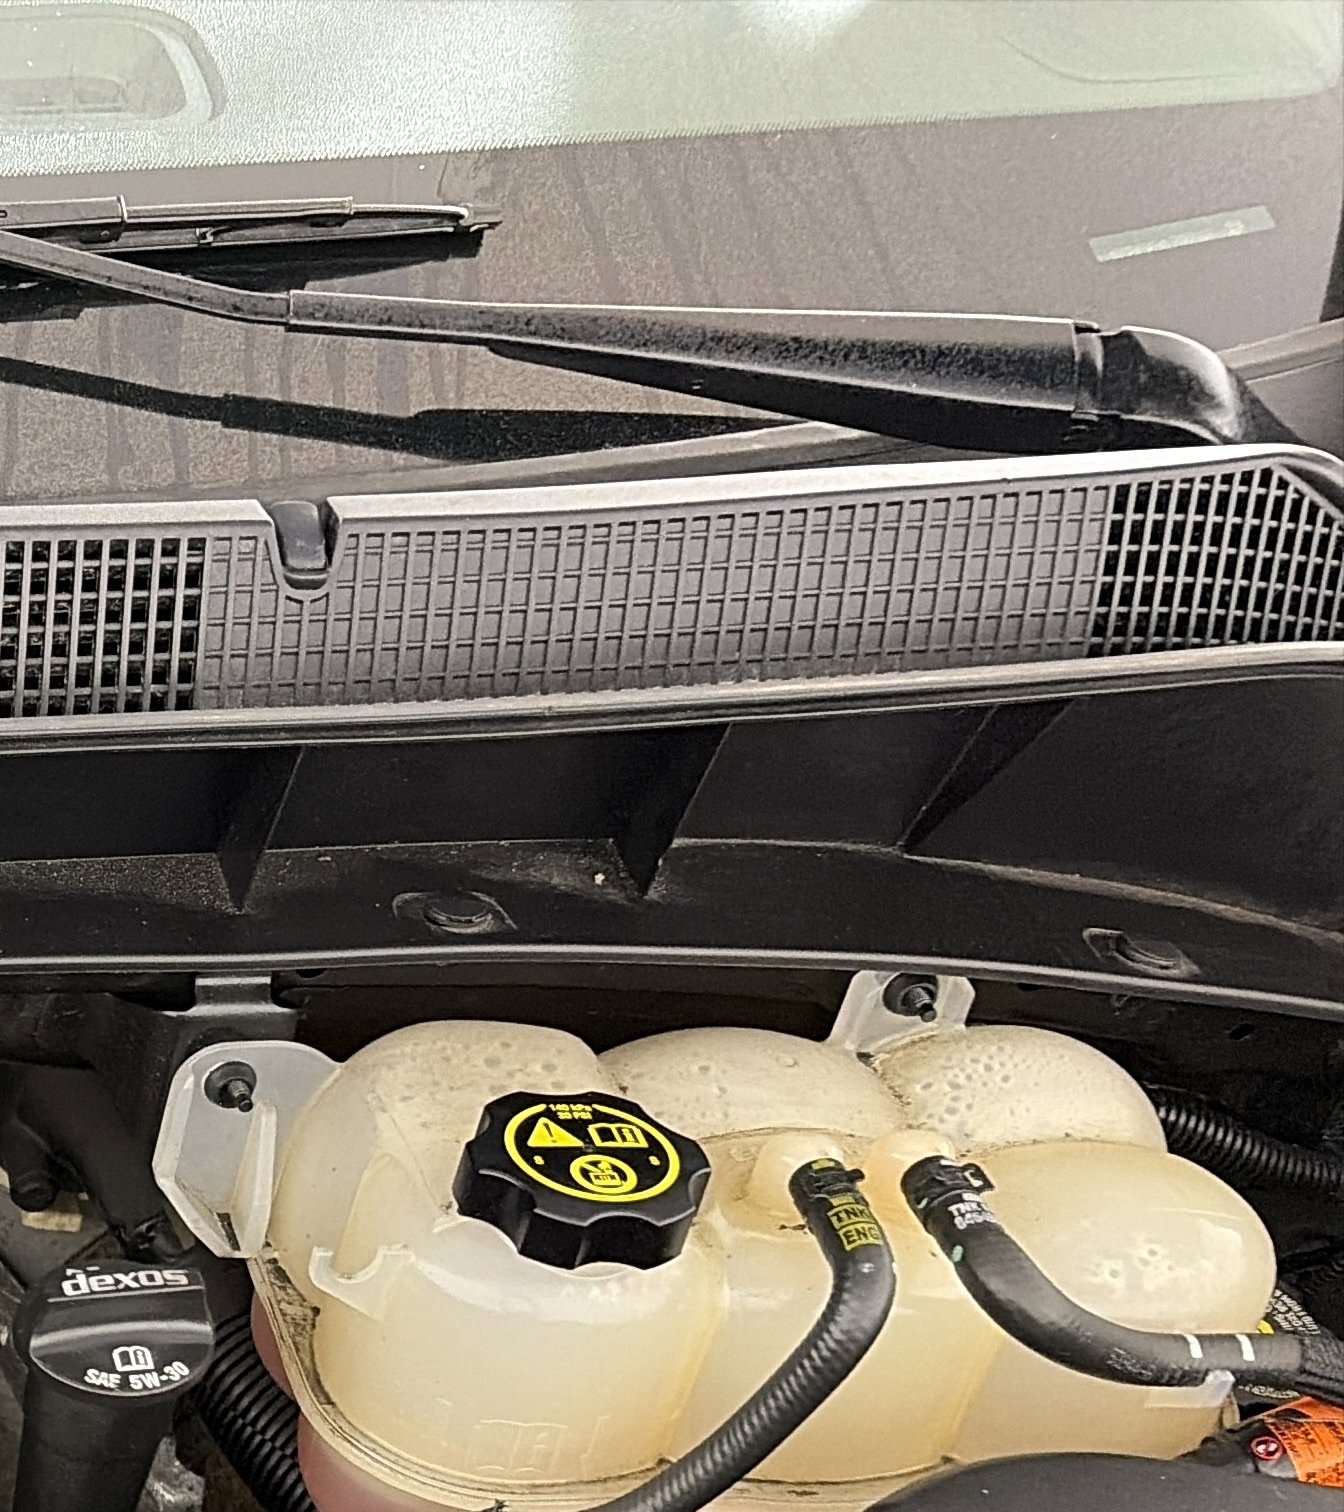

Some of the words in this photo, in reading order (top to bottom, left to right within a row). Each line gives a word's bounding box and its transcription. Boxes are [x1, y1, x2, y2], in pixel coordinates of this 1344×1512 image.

[842, 1225, 882, 1246] ENG
[62, 1269, 189, 1297] dexos
[83, 1368, 122, 1389] SAE
[128, 1360, 190, 1390] 5W-30
